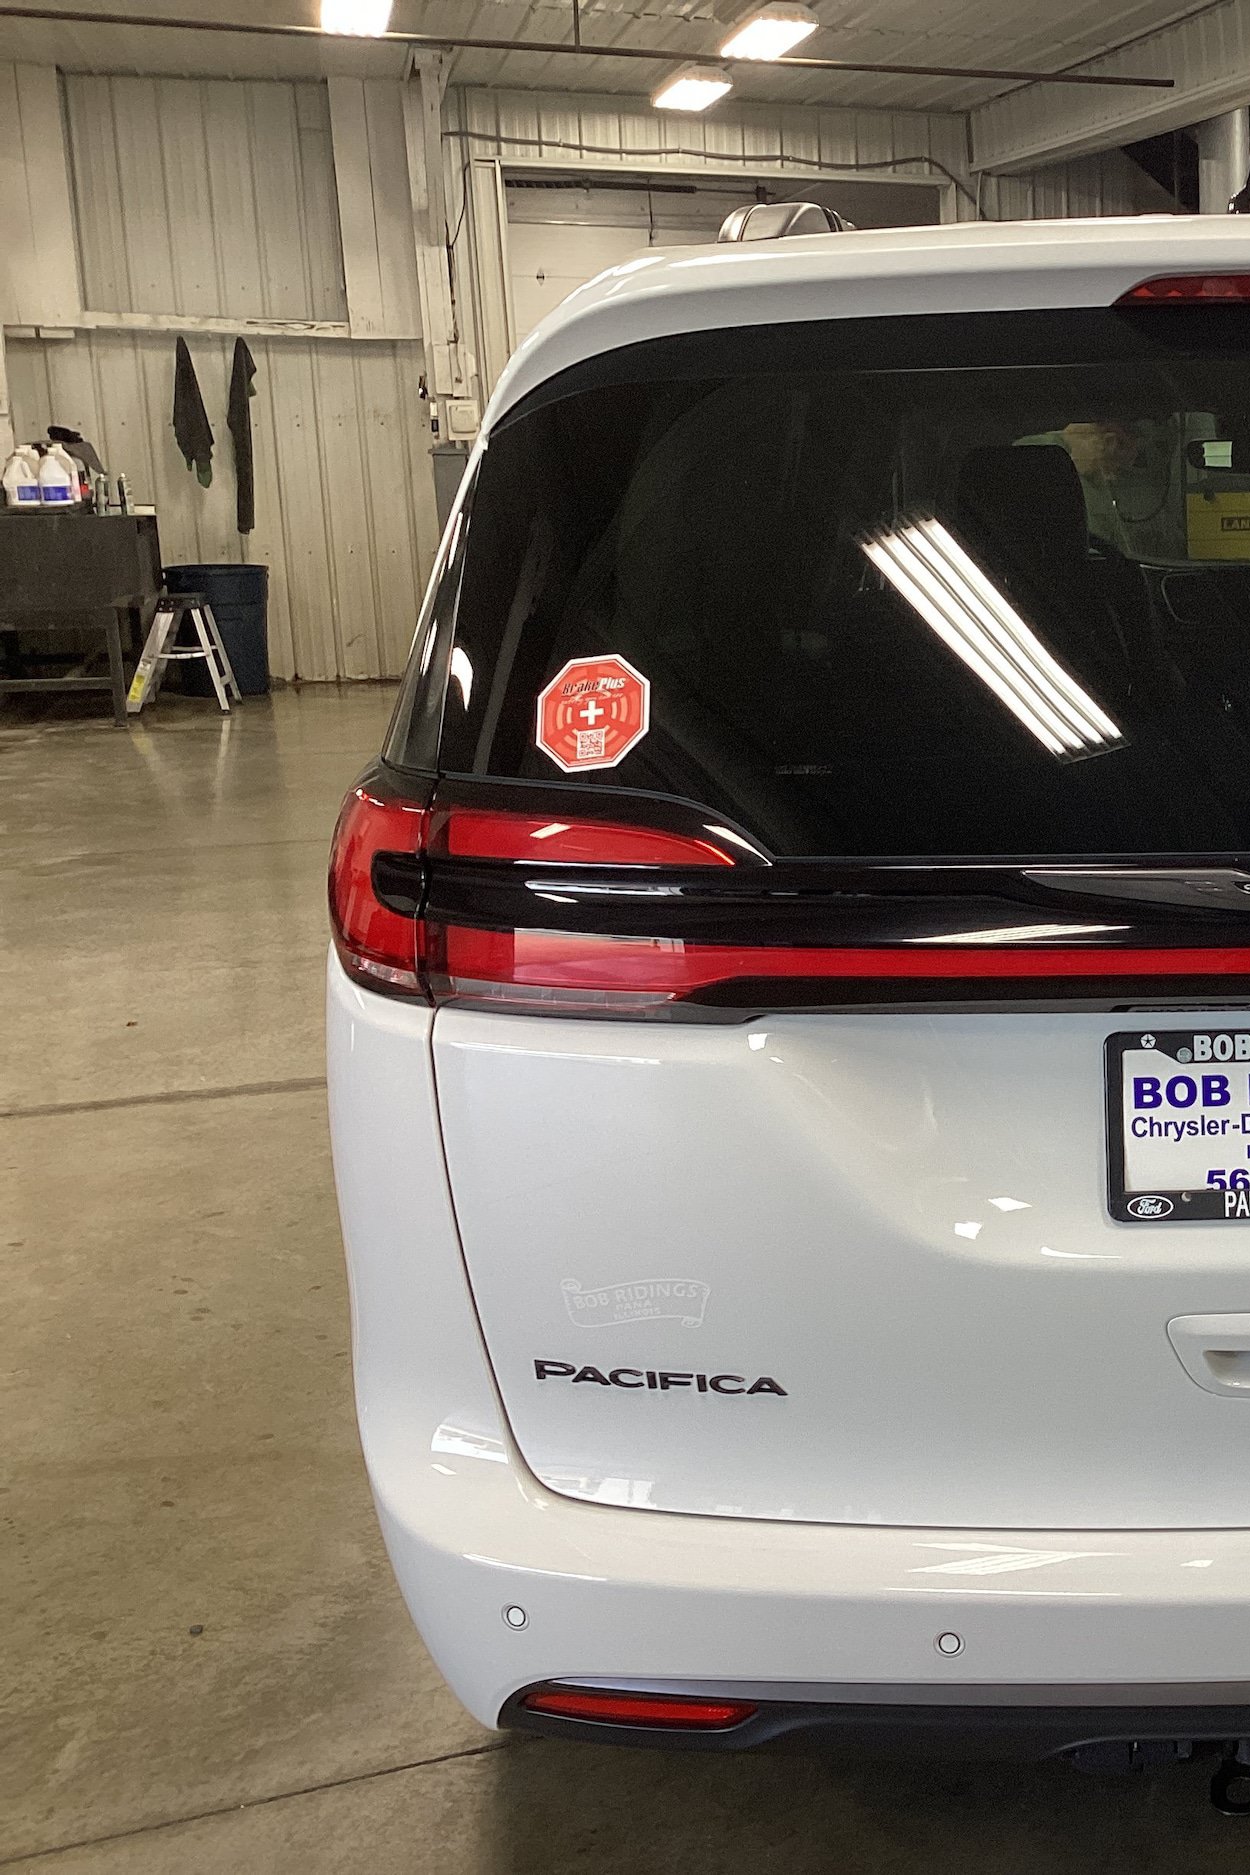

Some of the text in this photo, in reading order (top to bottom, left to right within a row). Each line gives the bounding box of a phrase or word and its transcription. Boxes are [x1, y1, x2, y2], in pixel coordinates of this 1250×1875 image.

[1133, 1074, 1231, 1110] BOB
[1138, 1198, 1163, 1216] Ford
[573, 1282, 698, 1310] BOB RIDINGS
[534, 1358, 788, 1396] PACIFICA
